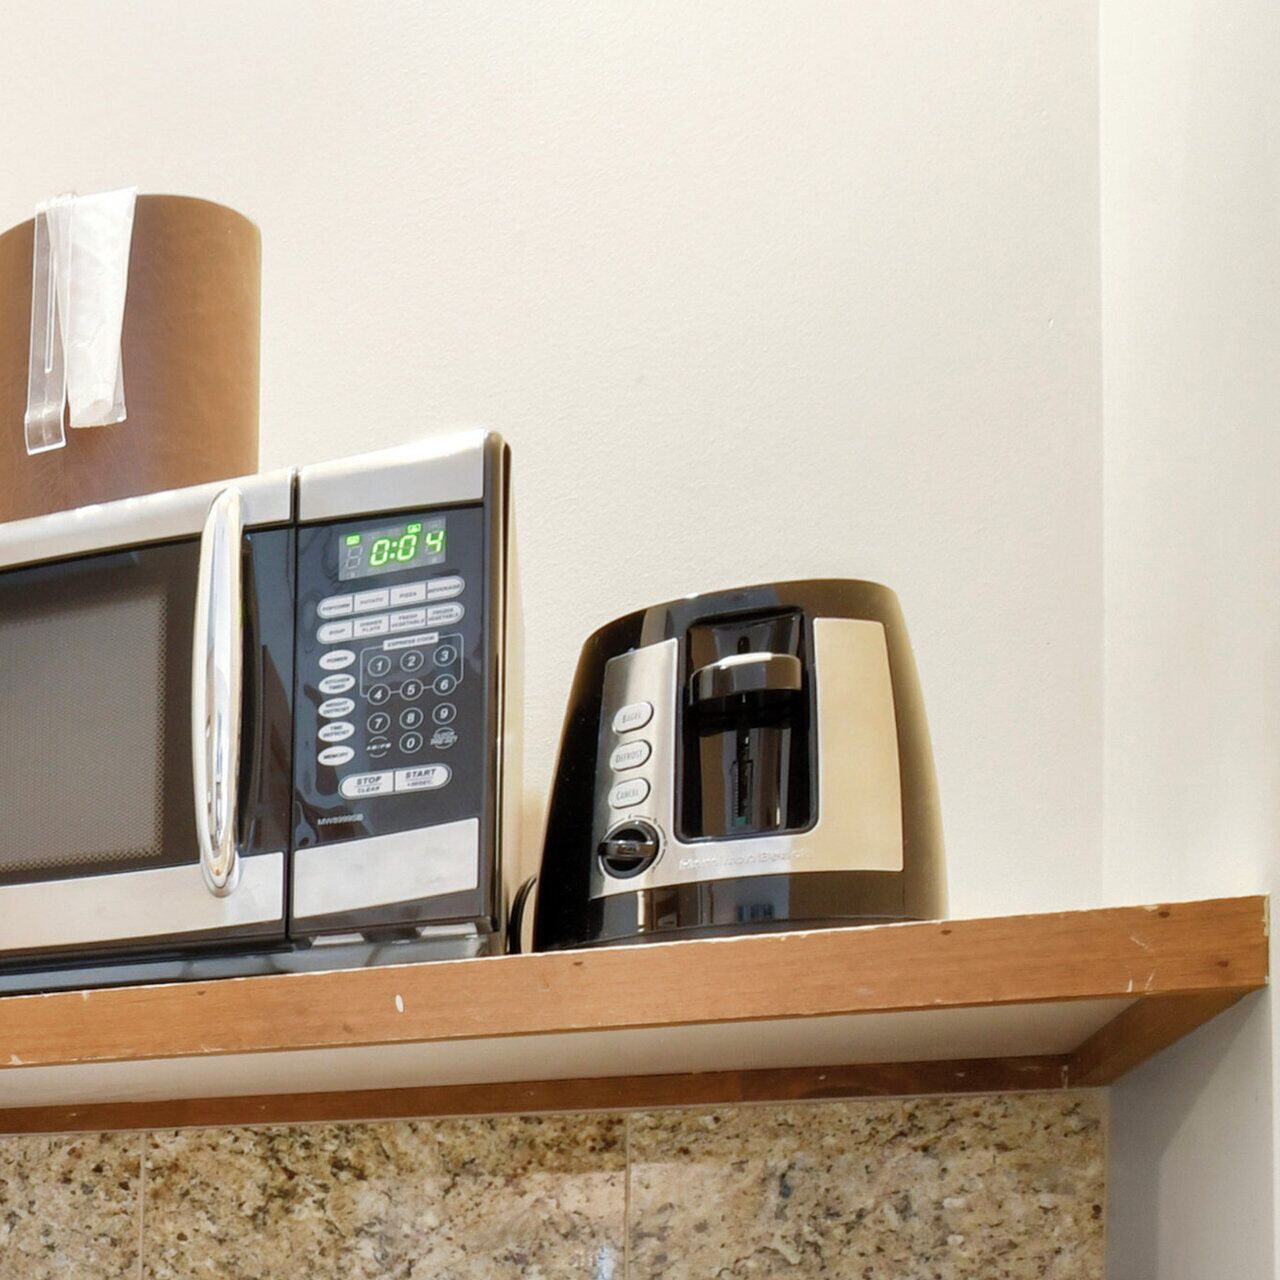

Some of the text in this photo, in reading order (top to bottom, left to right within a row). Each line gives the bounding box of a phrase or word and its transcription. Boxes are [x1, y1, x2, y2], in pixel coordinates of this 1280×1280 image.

[369, 530, 445, 566] 0:04
[407, 654, 416, 667] 2
[440, 649, 450, 662] 3
[376, 660, 383, 671] 1
[406, 683, 416, 696] 5
[440, 678, 449, 691] 6
[374, 689, 383, 700] 4
[406, 711, 416, 724] 8
[440, 707, 449, 720] 9
[374, 717, 383, 729] 7
[406, 736, 415, 749] 0
[356, 775, 382, 785] STOP
[405, 768, 437, 779] START
